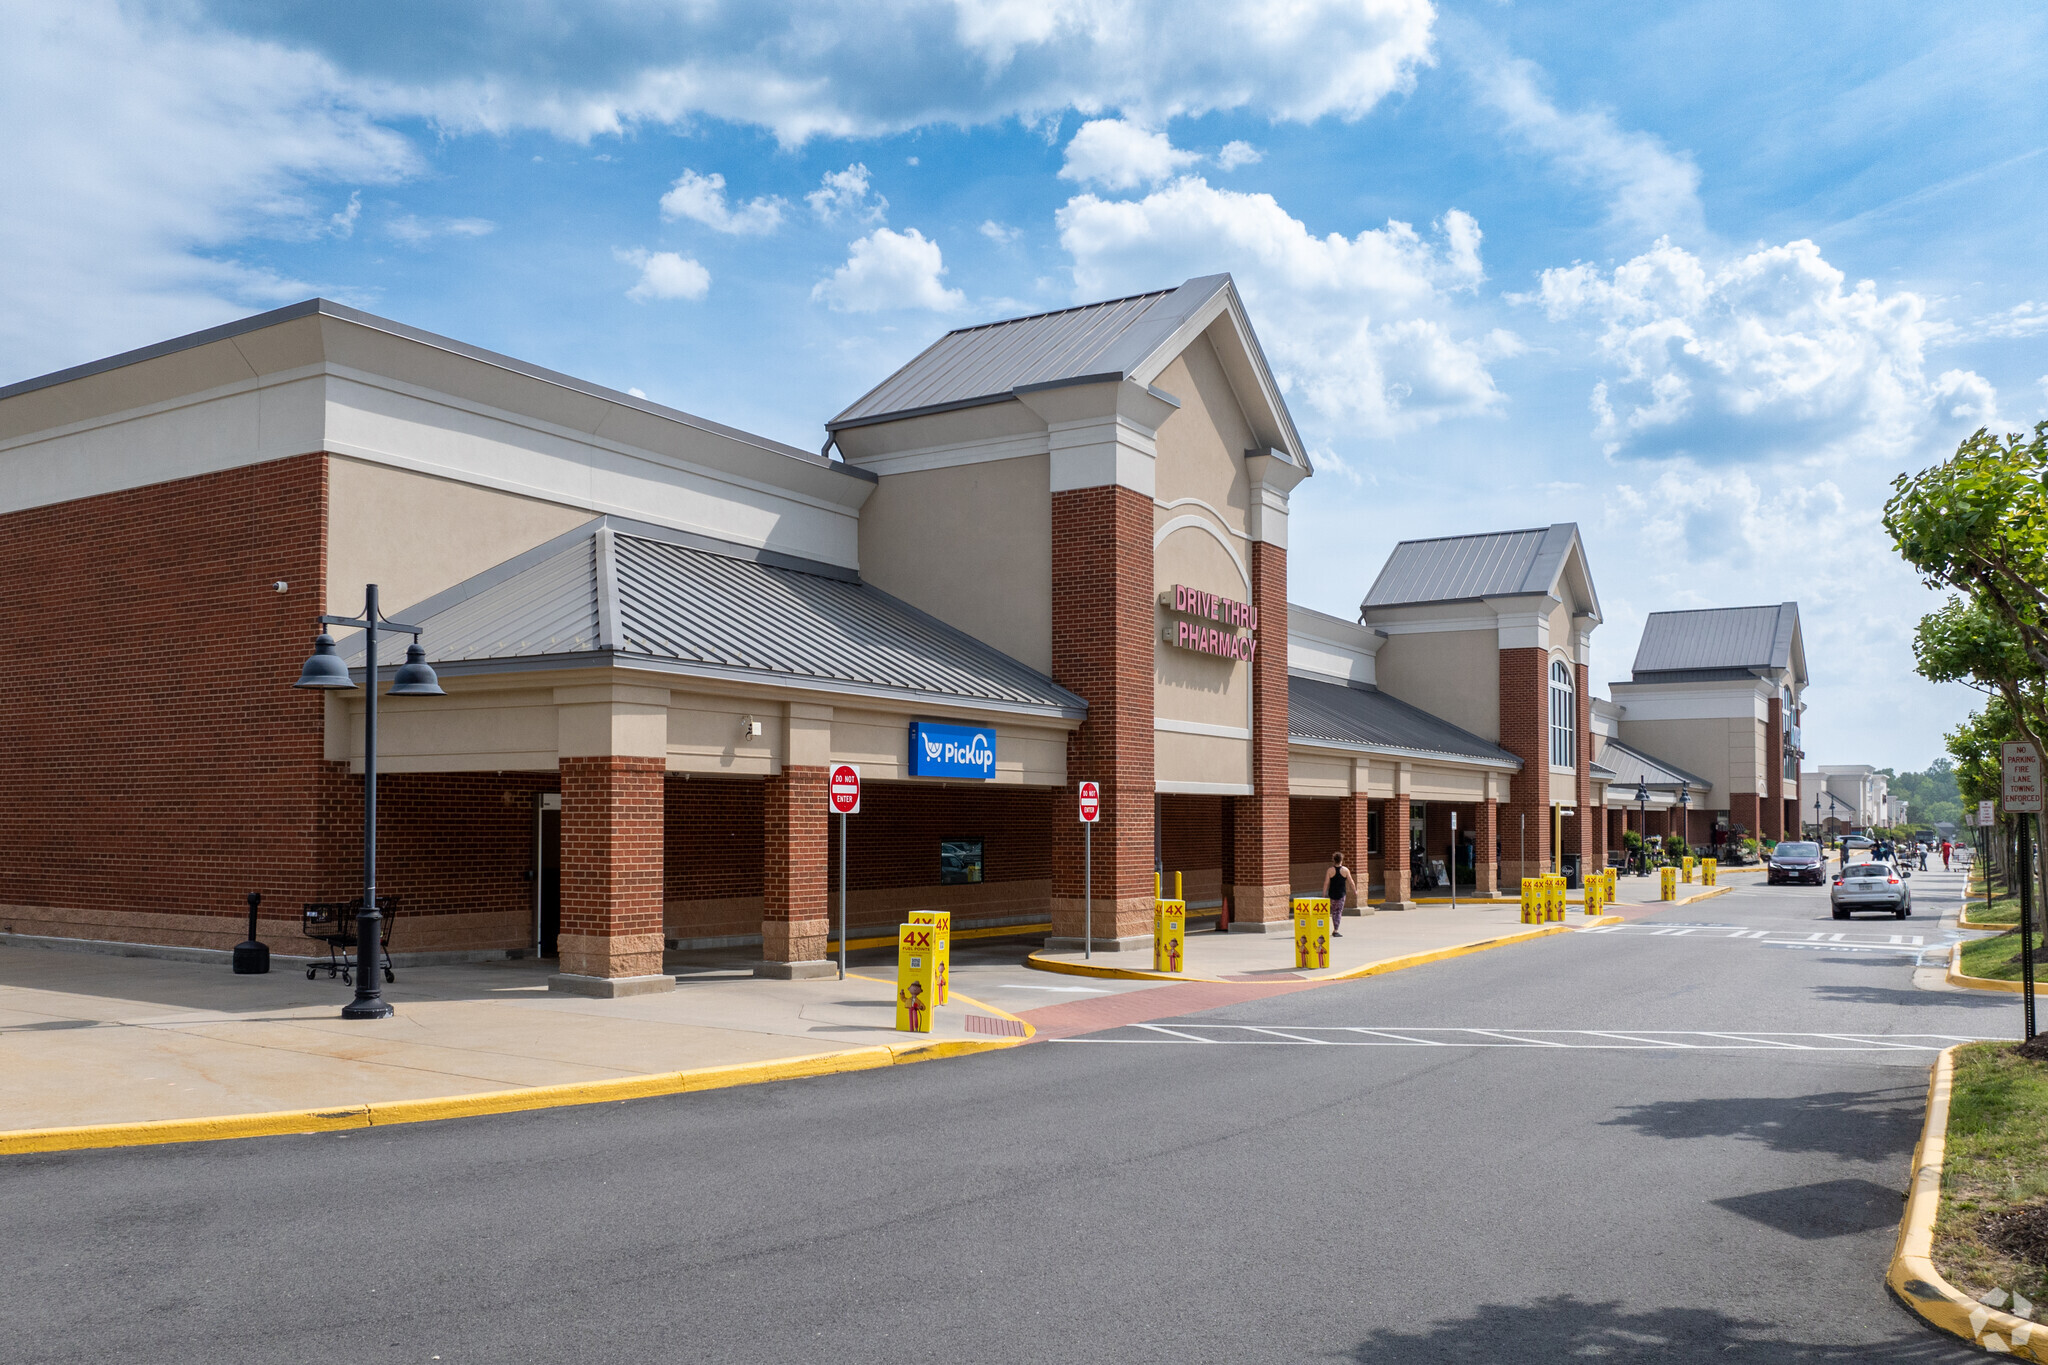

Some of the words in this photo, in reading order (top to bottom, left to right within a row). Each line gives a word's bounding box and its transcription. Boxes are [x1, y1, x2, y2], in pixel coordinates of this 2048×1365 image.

[1176, 584, 1219, 620] DRIVE
[1222, 597, 1258, 630] THRU
[1179, 621, 1257, 662] PHARMACY
[945, 734, 993, 773] Pickup
[2014, 765, 2030, 773] FIRE
[835, 775, 843, 783] DO
[844, 775, 855, 783] NOT
[2012, 775, 2031, 783] LANE
[836, 795, 853, 803] ENTER
[2005, 794, 2040, 802] ENFORCED
[1165, 904, 1183, 916] 4X
[1296, 903, 1309, 913] 4X
[1313, 903, 1328, 913] 4X
[936, 917, 949, 931] 4X
[903, 931, 930, 947] 4X
